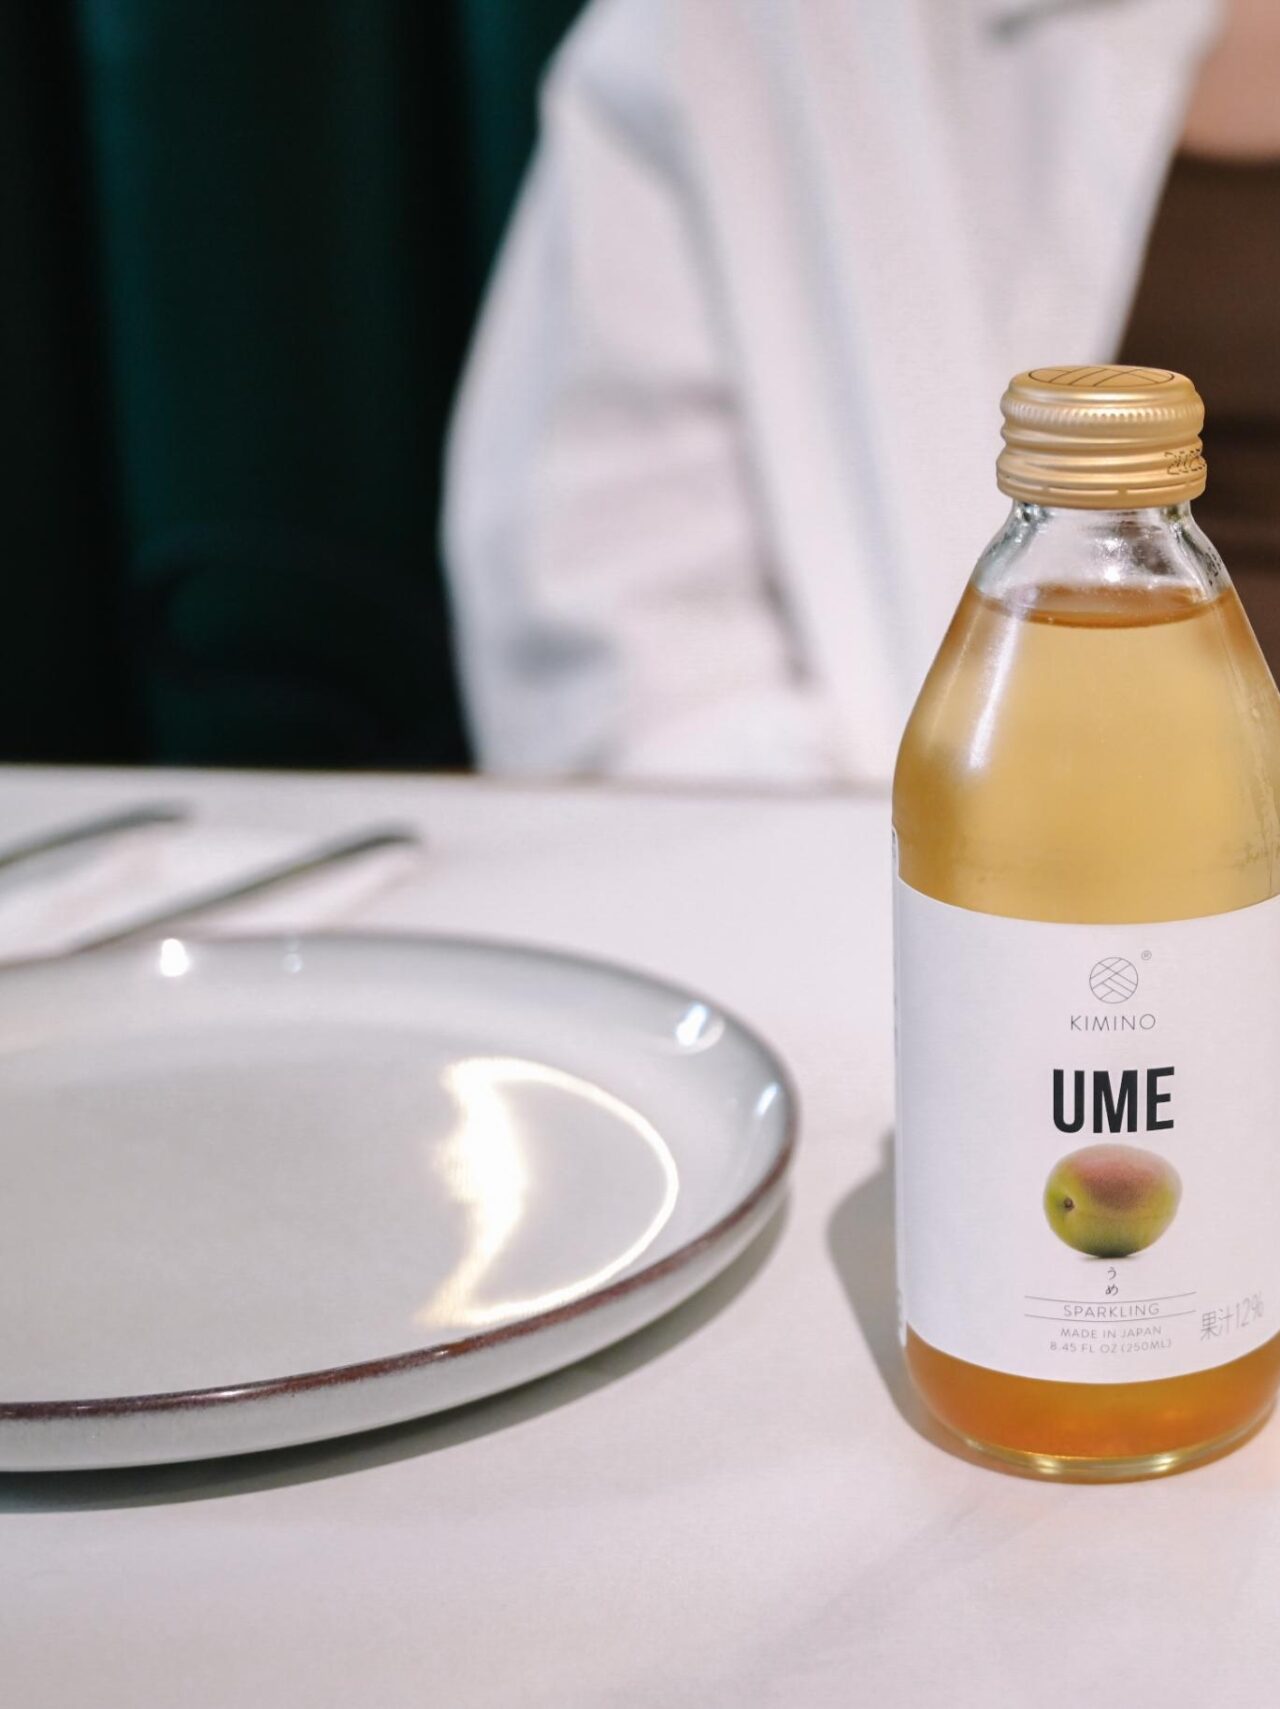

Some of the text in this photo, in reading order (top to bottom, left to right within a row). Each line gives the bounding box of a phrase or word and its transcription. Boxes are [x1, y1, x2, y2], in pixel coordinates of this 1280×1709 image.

[1070, 1013, 1156, 1031] KIMINO
[1053, 1066, 1175, 1133] UME
[1105, 1266, 1119, 1296] うめ
[1063, 1303, 1160, 1318] SPARKLING
[1060, 1326, 1162, 1339] MADE IN JAPAN
[1049, 1341, 1077, 1352] 8.45
[1081, 1343, 1095, 1353] FL
[1100, 1343, 1118, 1353] OZ
